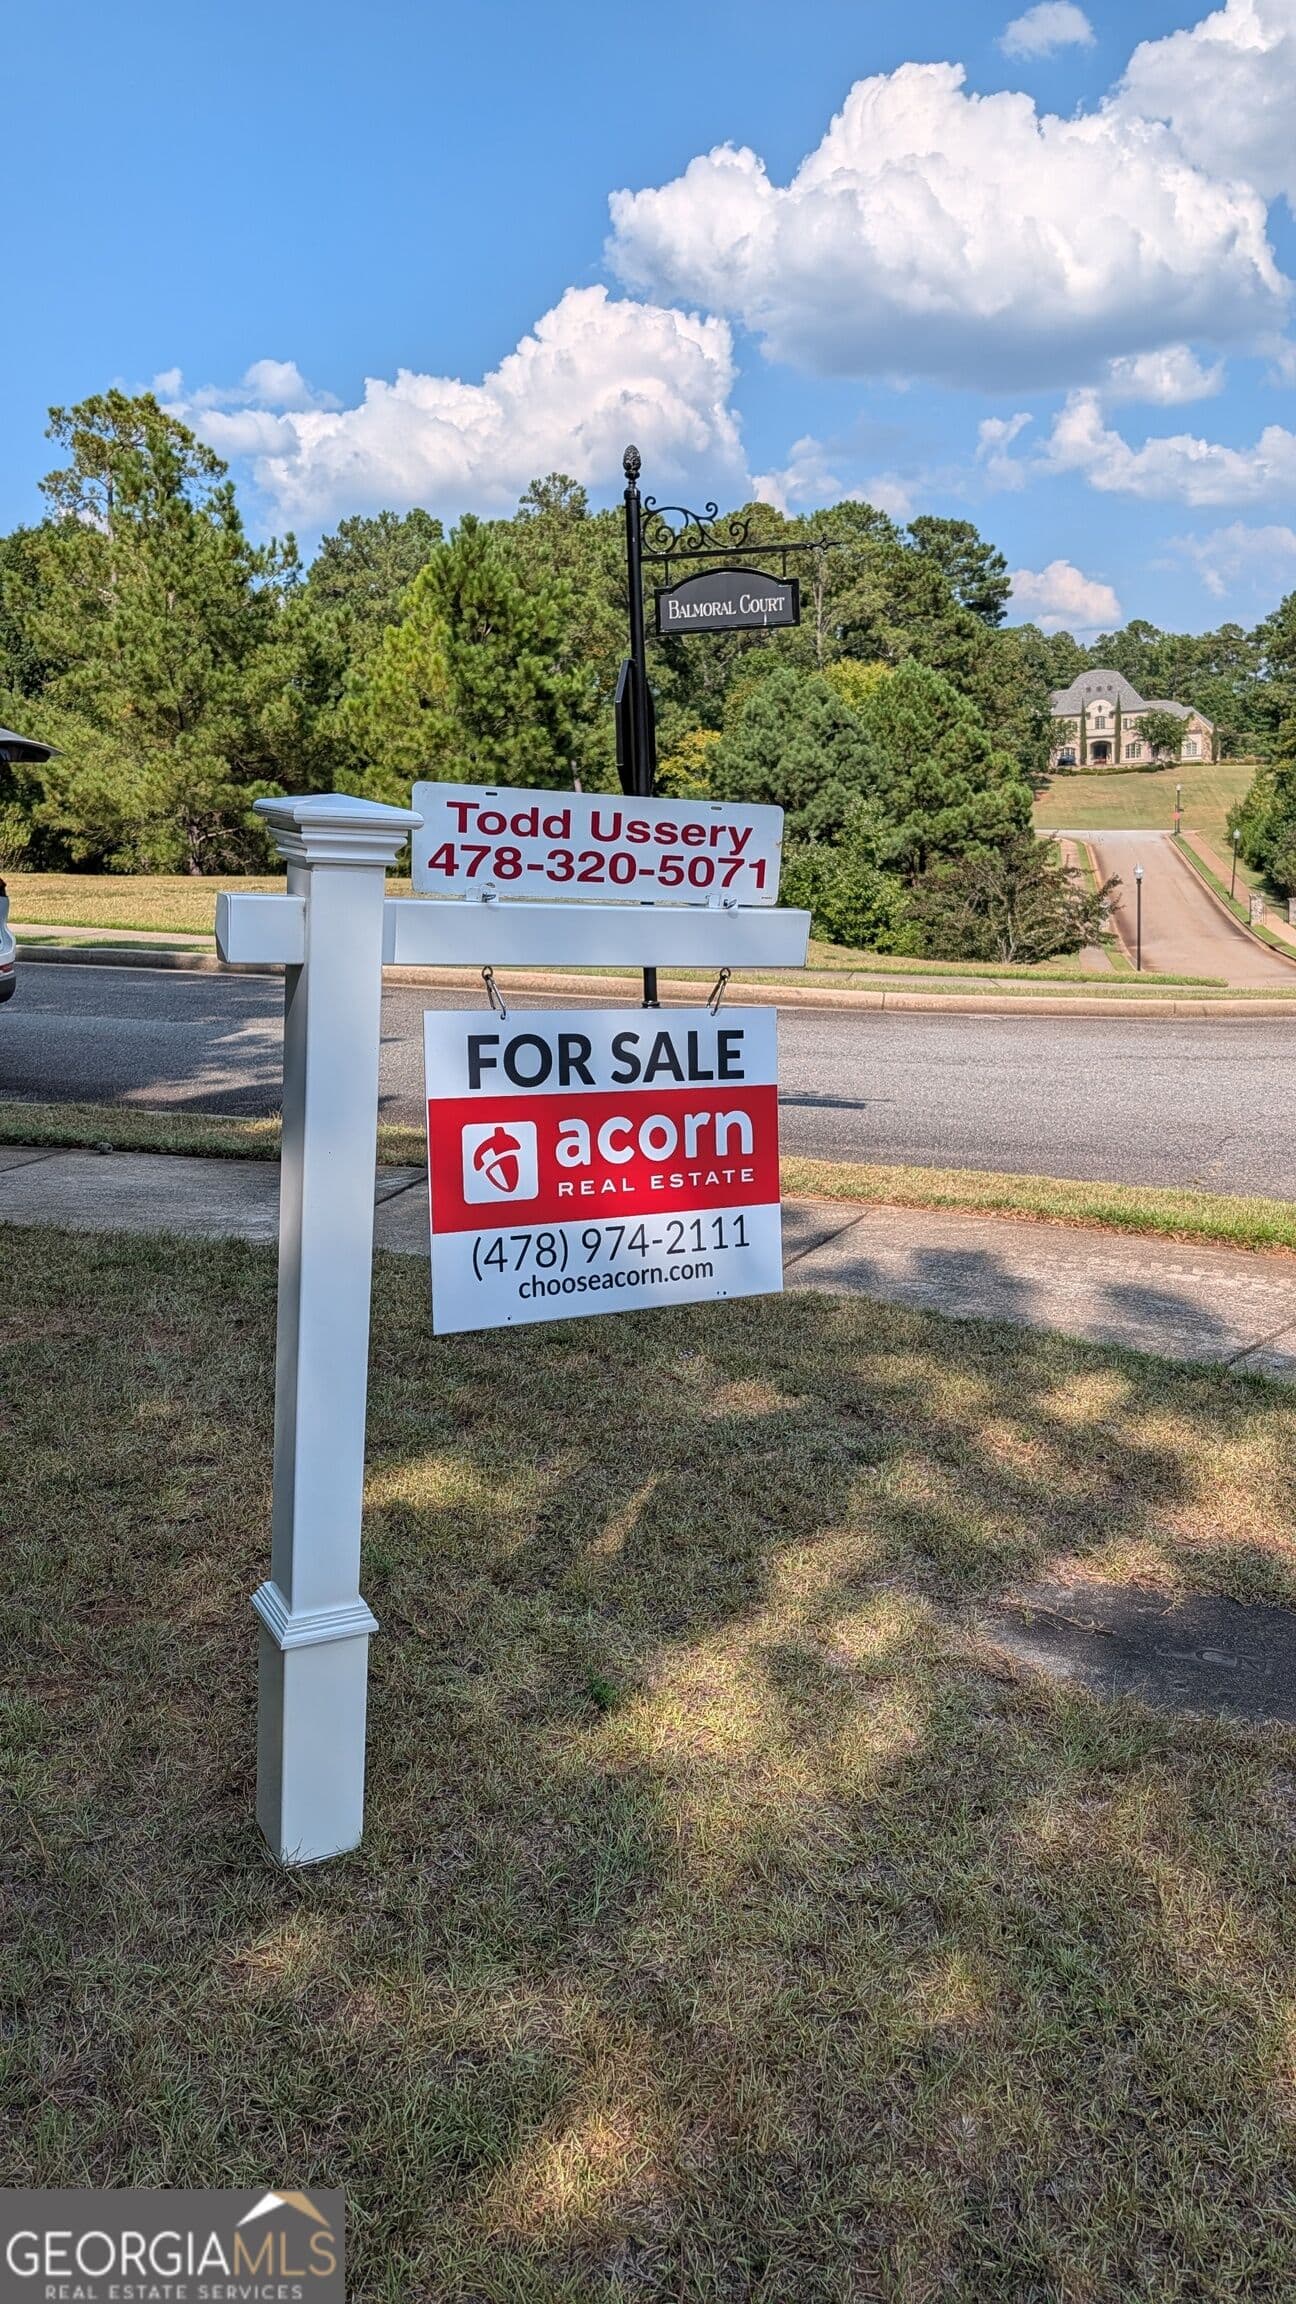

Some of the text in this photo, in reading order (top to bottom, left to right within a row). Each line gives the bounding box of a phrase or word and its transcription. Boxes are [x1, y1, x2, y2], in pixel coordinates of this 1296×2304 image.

[668, 594, 785, 620] BALMORAL COURT
[446, 801, 754, 856] Todd Ussery
[427, 843, 767, 889] 478-320-5071
[467, 1029, 745, 1090] FOR SALE
[555, 1109, 754, 1168] acorn
[557, 1168, 755, 1197] REAL ESTATE
[471, 1214, 750, 1282] (478) 974-2111
[518, 1260, 714, 1300] chooseacorn.com
